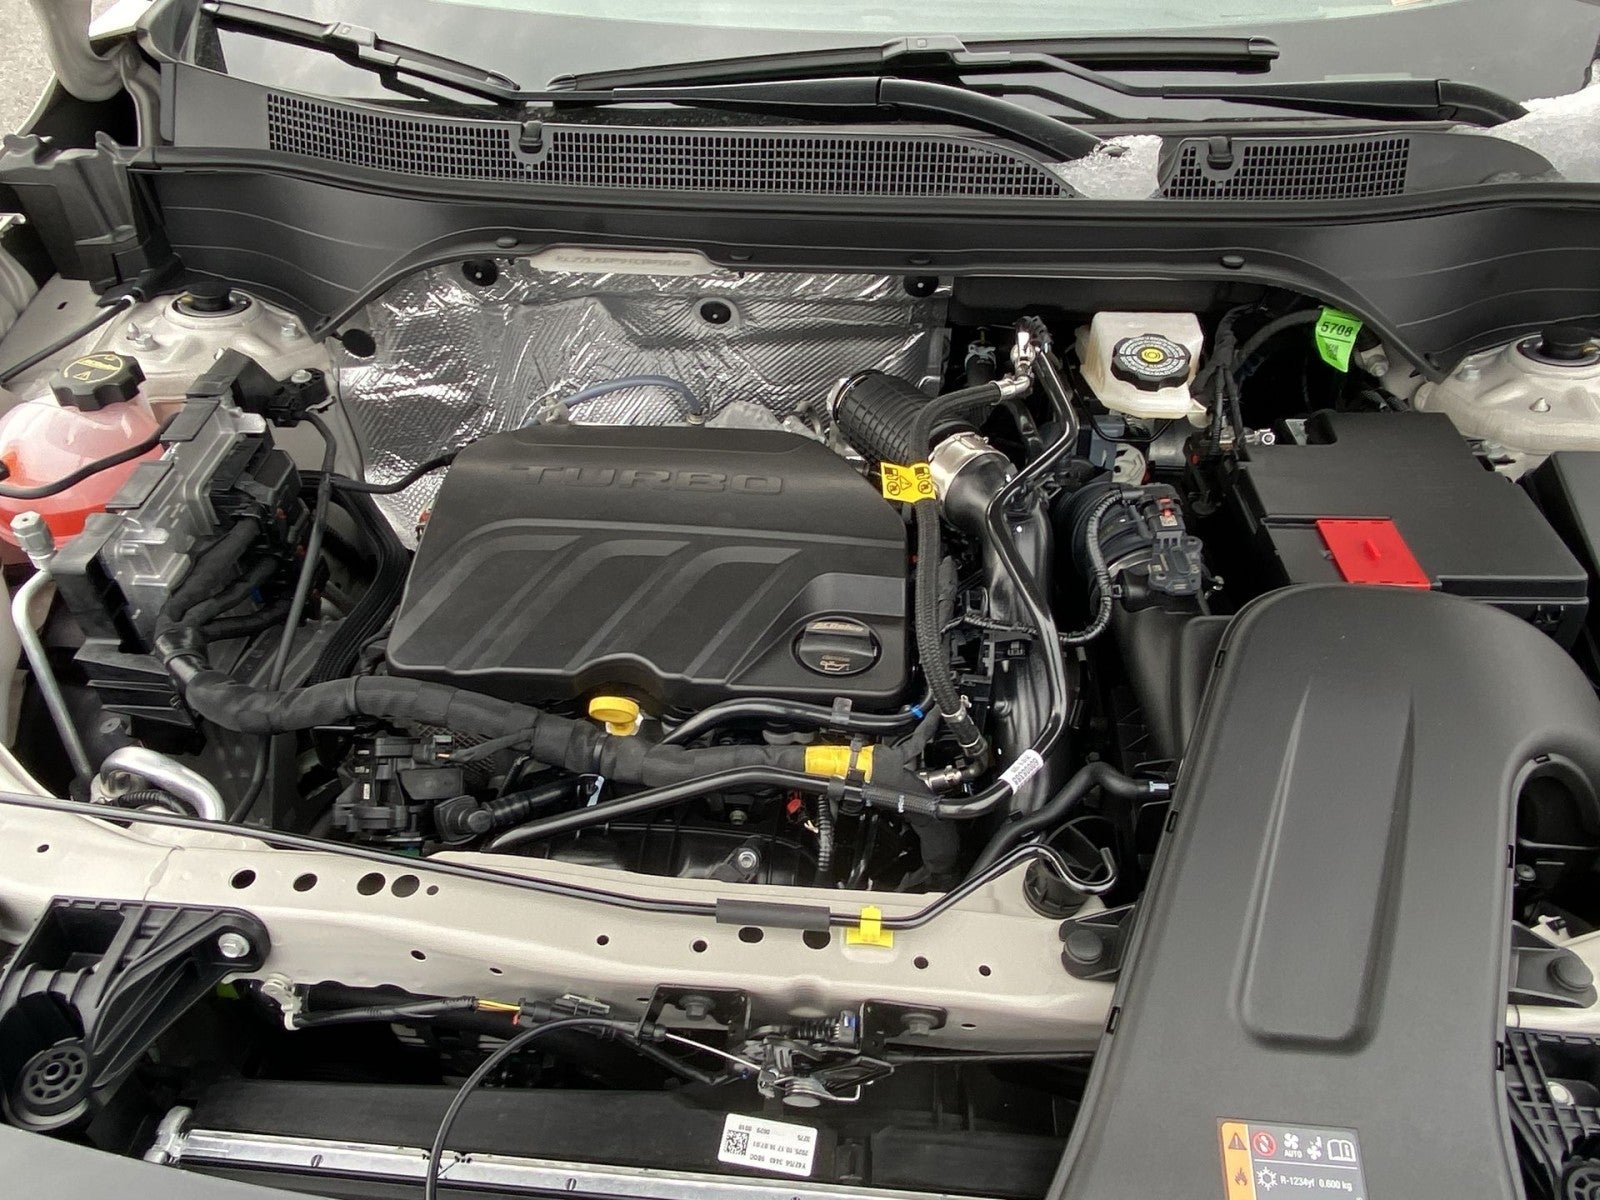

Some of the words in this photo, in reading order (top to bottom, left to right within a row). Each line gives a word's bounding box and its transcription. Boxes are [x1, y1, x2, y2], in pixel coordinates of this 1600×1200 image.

[1320, 321, 1354, 338] 5708
[511, 465, 784, 496] TURBO
[1283, 1149, 1303, 1159] AUTO
[1280, 1175, 1315, 1189] R-1234yf
[1318, 1178, 1341, 1190] 0.600
[1342, 1181, 1353, 1192] kg
